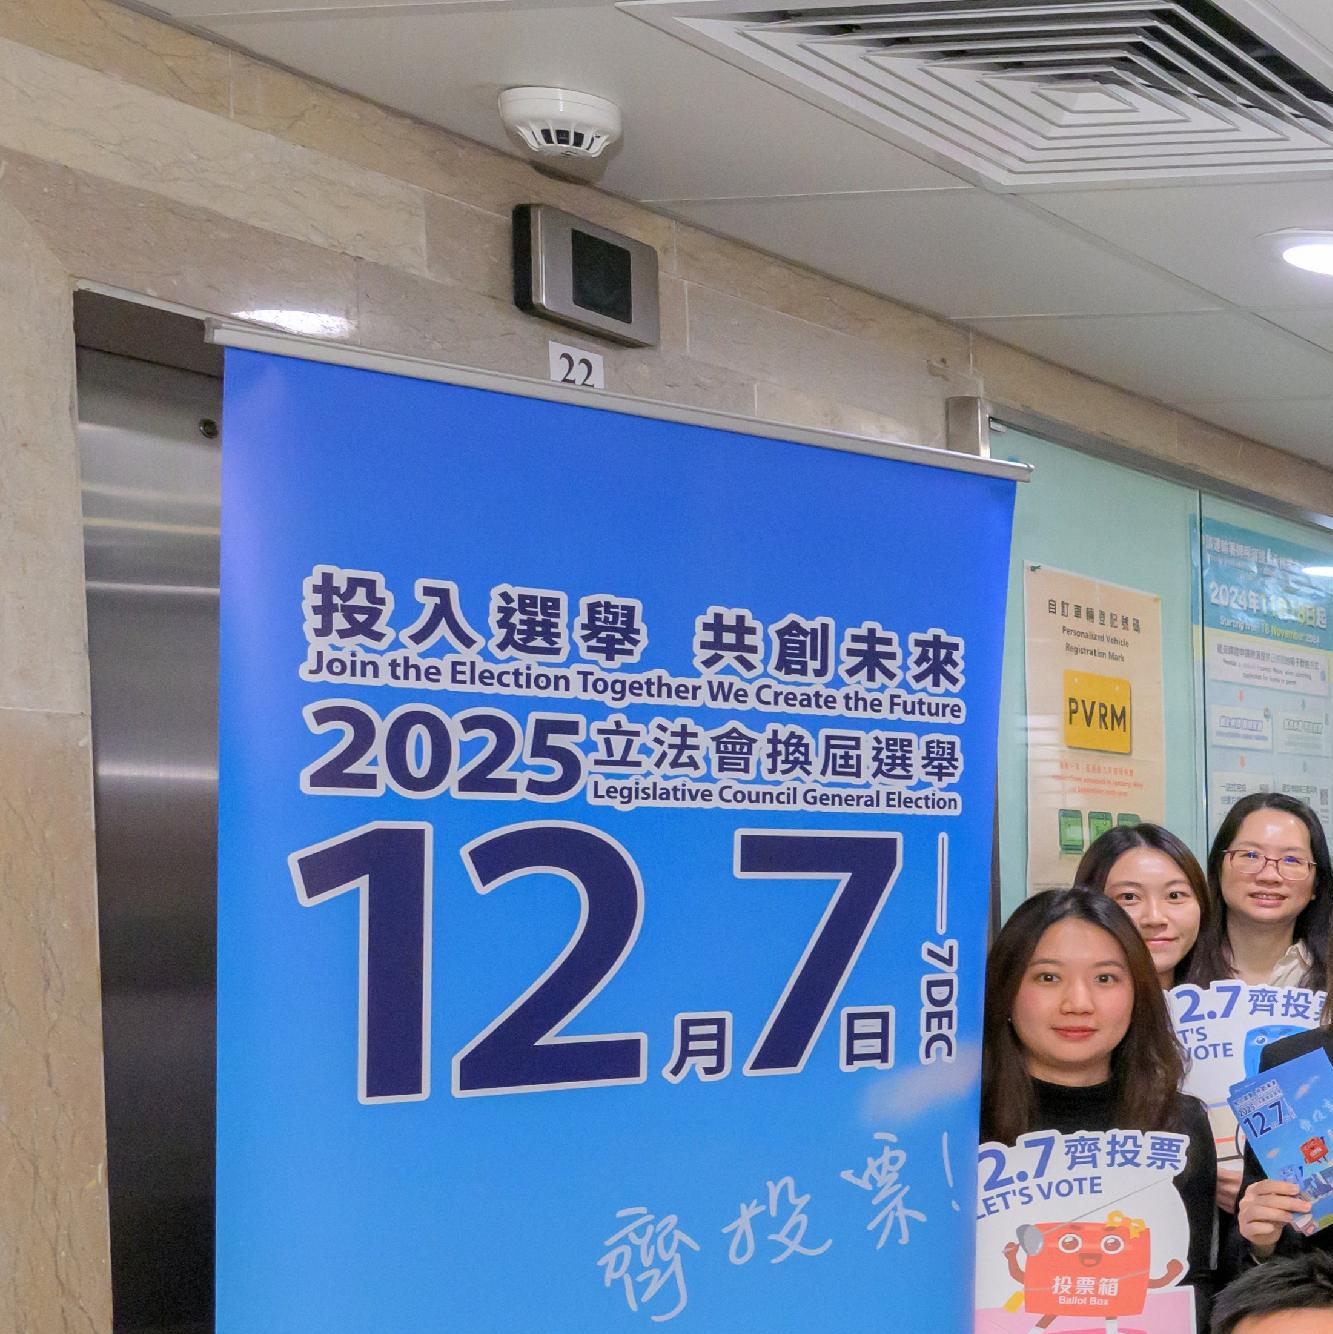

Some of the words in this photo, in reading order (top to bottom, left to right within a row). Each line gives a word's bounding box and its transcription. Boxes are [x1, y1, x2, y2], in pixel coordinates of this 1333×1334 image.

[559, 352, 595, 388] 22
[311, 571, 641, 662] 投入選舉
[699, 612, 961, 688] 共創未來
[308, 650, 380, 680] Join
[387, 656, 442, 684] the
[450, 660, 570, 692] Election
[577, 671, 702, 702] Together
[707, 680, 749, 704] We
[755, 683, 837, 711] Create
[842, 691, 883, 714] the
[889, 694, 962, 719] Future
[1068, 697, 1127, 732] PVRM
[309, 704, 582, 797] 2025
[593, 719, 959, 783] 立法會換屆選舉
[593, 780, 713, 806] Legislative
[717, 787, 797, 806] Council
[802, 788, 880, 808] General
[885, 790, 958, 811] Election
[925, 979, 954, 1060] DEC
[1175, 985, 1242, 1024] 2.7
[1178, 1026, 1208, 1045] T'S
[978, 1135, 1056, 1192] 2.7
[1064, 1134, 1185, 1171] 齊投票
[1041, 1175, 1103, 1200] VOTE
[1051, 1275, 1119, 1297] 投票箱
[1058, 1294, 1088, 1306] Ballot
[1089, 1296, 1109, 1306] Box
